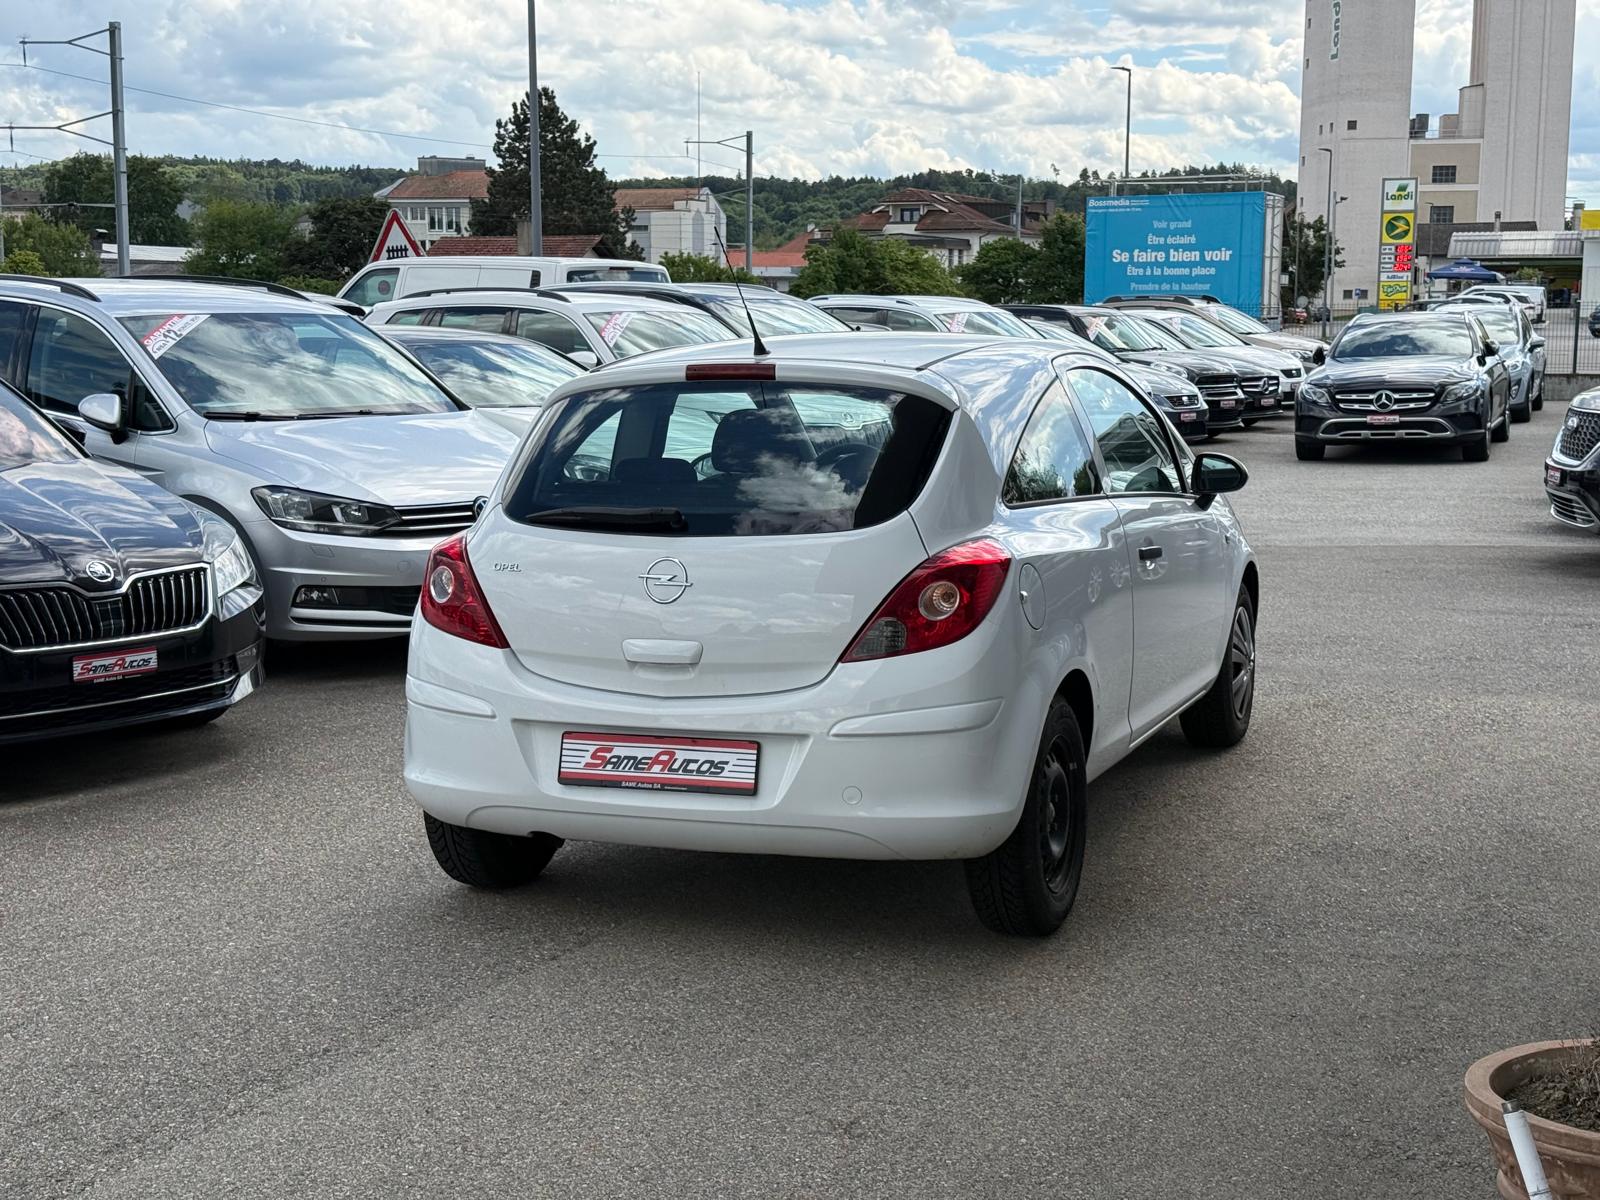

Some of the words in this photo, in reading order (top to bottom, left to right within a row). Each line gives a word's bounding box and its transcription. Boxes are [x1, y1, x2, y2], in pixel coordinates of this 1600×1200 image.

[1330, 0, 1341, 60] Land
[1385, 191, 1413, 201] Landi
[1088, 199, 1130, 207] Bossmedia
[1153, 220, 1168, 229] Voir
[1170, 220, 1192, 229] grand
[1147, 233, 1165, 245] Être
[1167, 233, 1196, 244] éclairé
[1112, 249, 1129, 263] Se
[1133, 248, 1166, 262] faire
[1170, 248, 1200, 262] bien
[1204, 247, 1232, 261] voir
[1126, 264, 1144, 276] Être
[1145, 264, 1152, 276] à
[1153, 266, 1161, 276] la
[1163, 266, 1190, 276] bonne
[1191, 266, 1216, 277] place
[1130, 281, 1159, 291] Prendre
[1161, 282, 1171, 291] de
[1172, 281, 1179, 291] la
[1181, 281, 1211, 291] hauteur
[493, 561, 522, 572] OPEL
